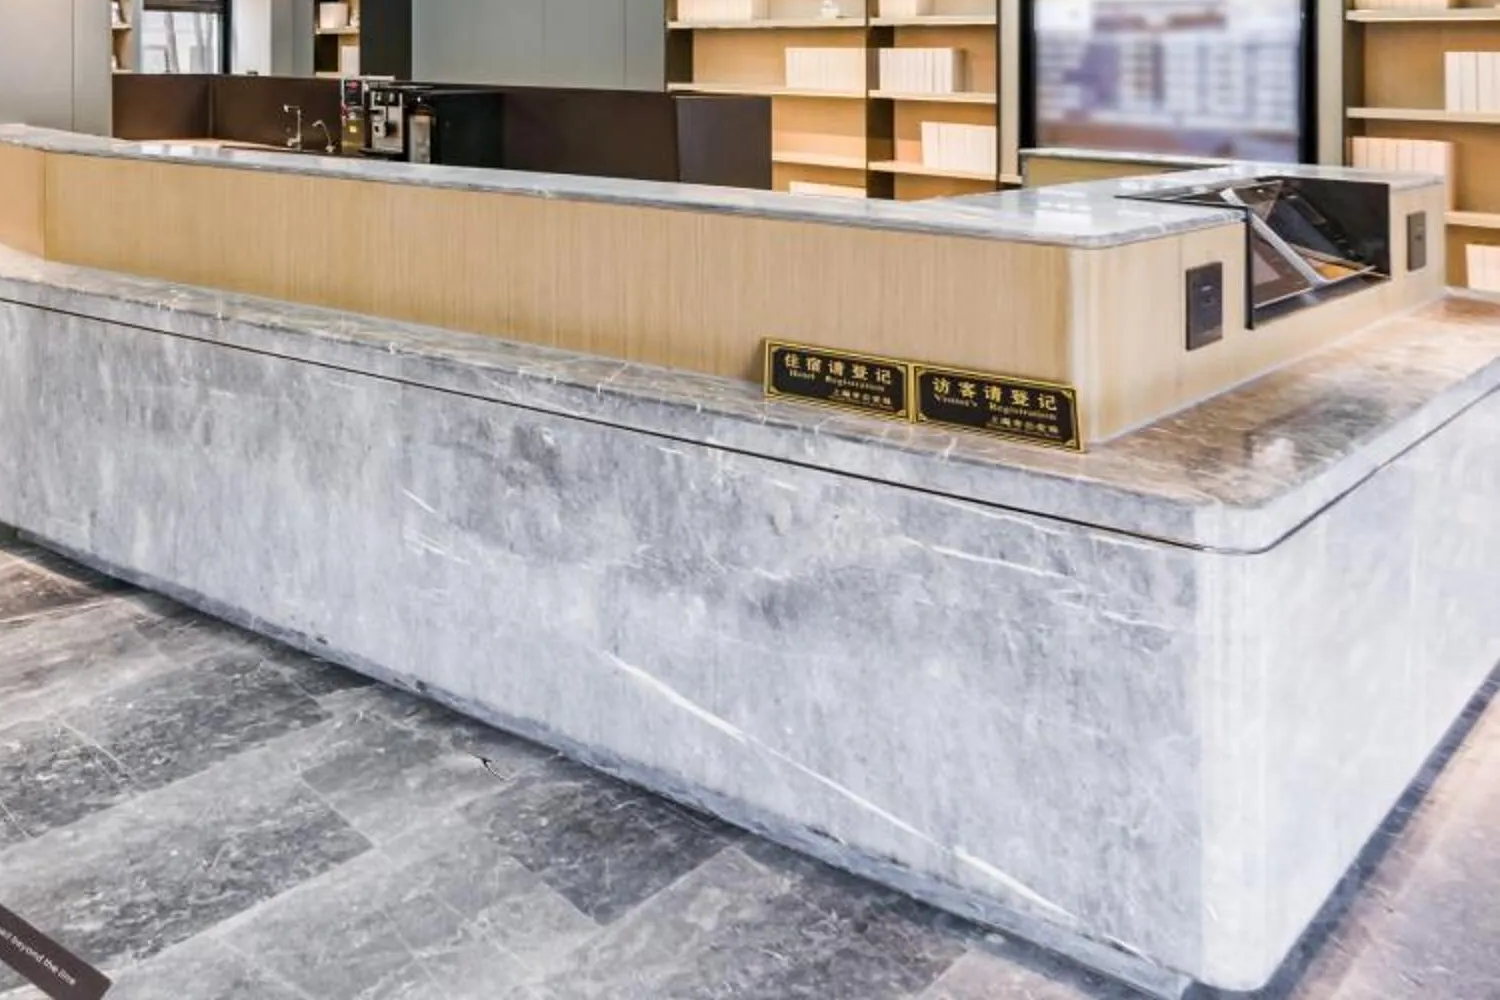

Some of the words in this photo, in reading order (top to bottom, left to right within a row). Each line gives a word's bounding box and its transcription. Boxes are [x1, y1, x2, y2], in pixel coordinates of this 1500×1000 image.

[784, 352, 893, 386] 住宿请登记
[932, 376, 1058, 411] 访客请登记
[11, 935, 45, 963] beyond
[43, 957, 59, 974] the
